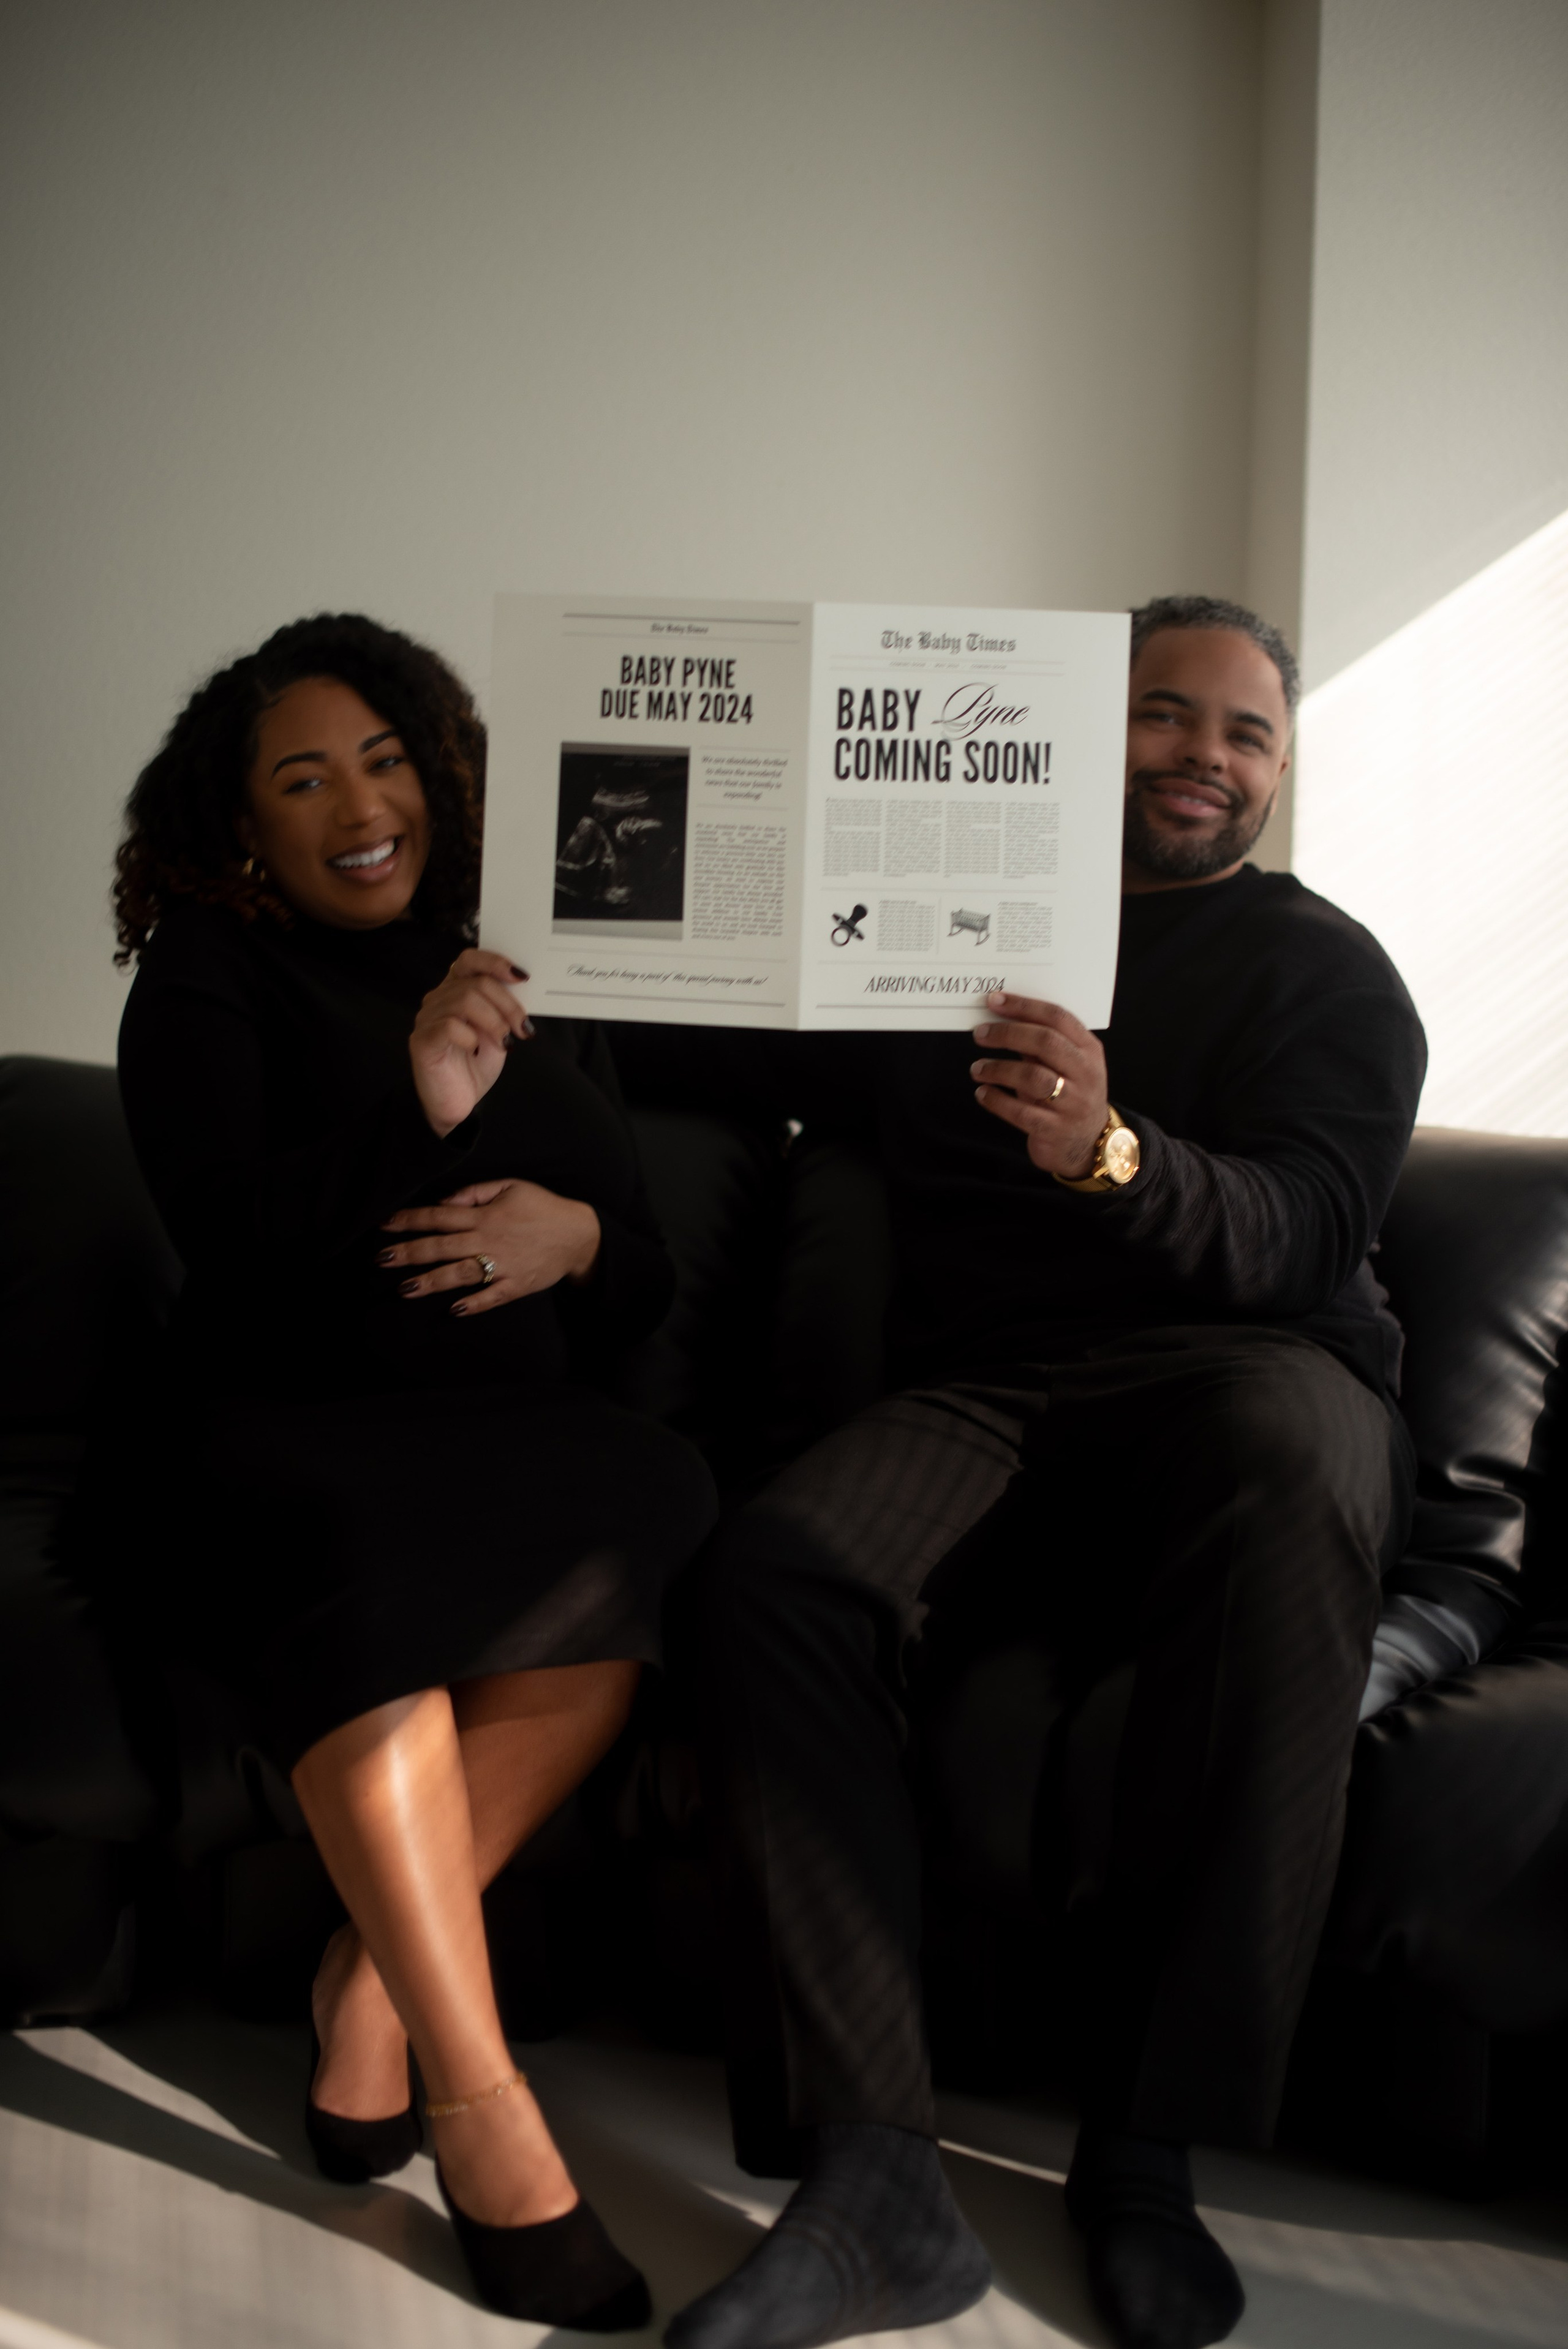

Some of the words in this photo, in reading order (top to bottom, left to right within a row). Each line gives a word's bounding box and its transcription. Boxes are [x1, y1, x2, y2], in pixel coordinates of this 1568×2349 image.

[881, 630, 913, 653] The
[918, 630, 962, 655] Baby
[966, 632, 1016, 652] Times
[620, 655, 676, 687] BABY
[682, 657, 737, 689] PYNE
[600, 688, 640, 719] DUE
[646, 690, 692, 723] MAY
[698, 693, 753, 725] 2024
[837, 687, 922, 733] BABY
[930, 681, 1031, 742] Pyne
[834, 737, 952, 783] COMING
[963, 740, 1052, 785] SOON!
[864, 975, 937, 994] ARRIVING
[937, 976, 973, 994] MAY
[971, 977, 1006, 994] 2024
